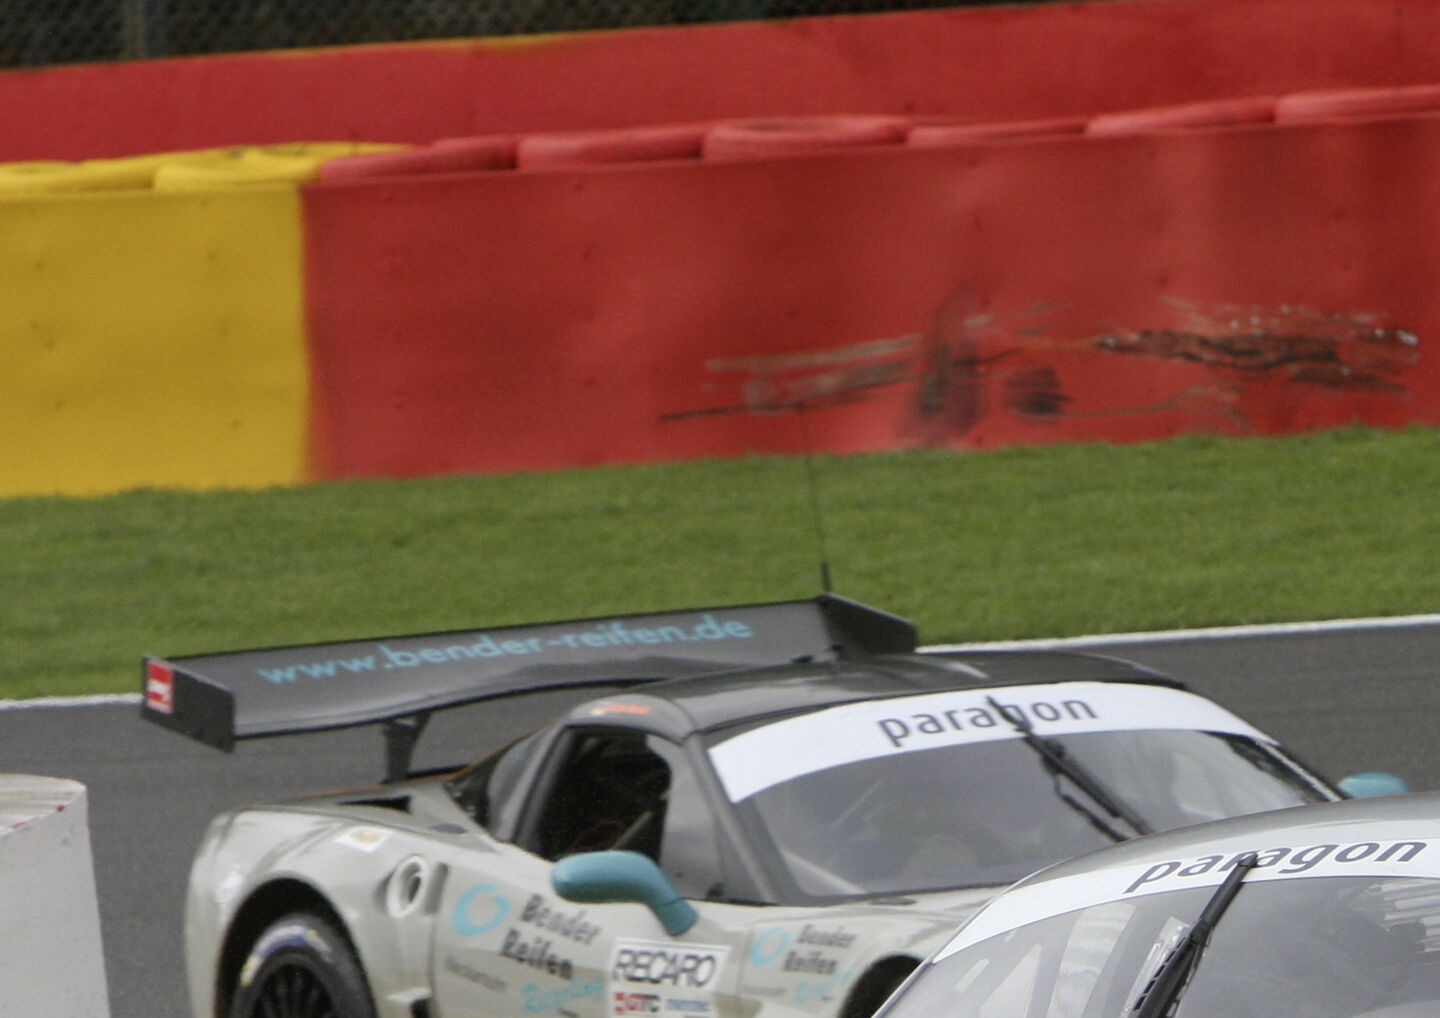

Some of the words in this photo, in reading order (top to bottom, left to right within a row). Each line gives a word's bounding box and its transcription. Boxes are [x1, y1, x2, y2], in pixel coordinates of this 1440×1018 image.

[258, 613, 752, 685] www.bender-reifen.de
[877, 699, 1098, 747] paragon
[1122, 841, 1428, 894] paragon
[519, 893, 602, 945] Bender
[500, 928, 573, 981] Reifen
[612, 948, 716, 987] RECARO
